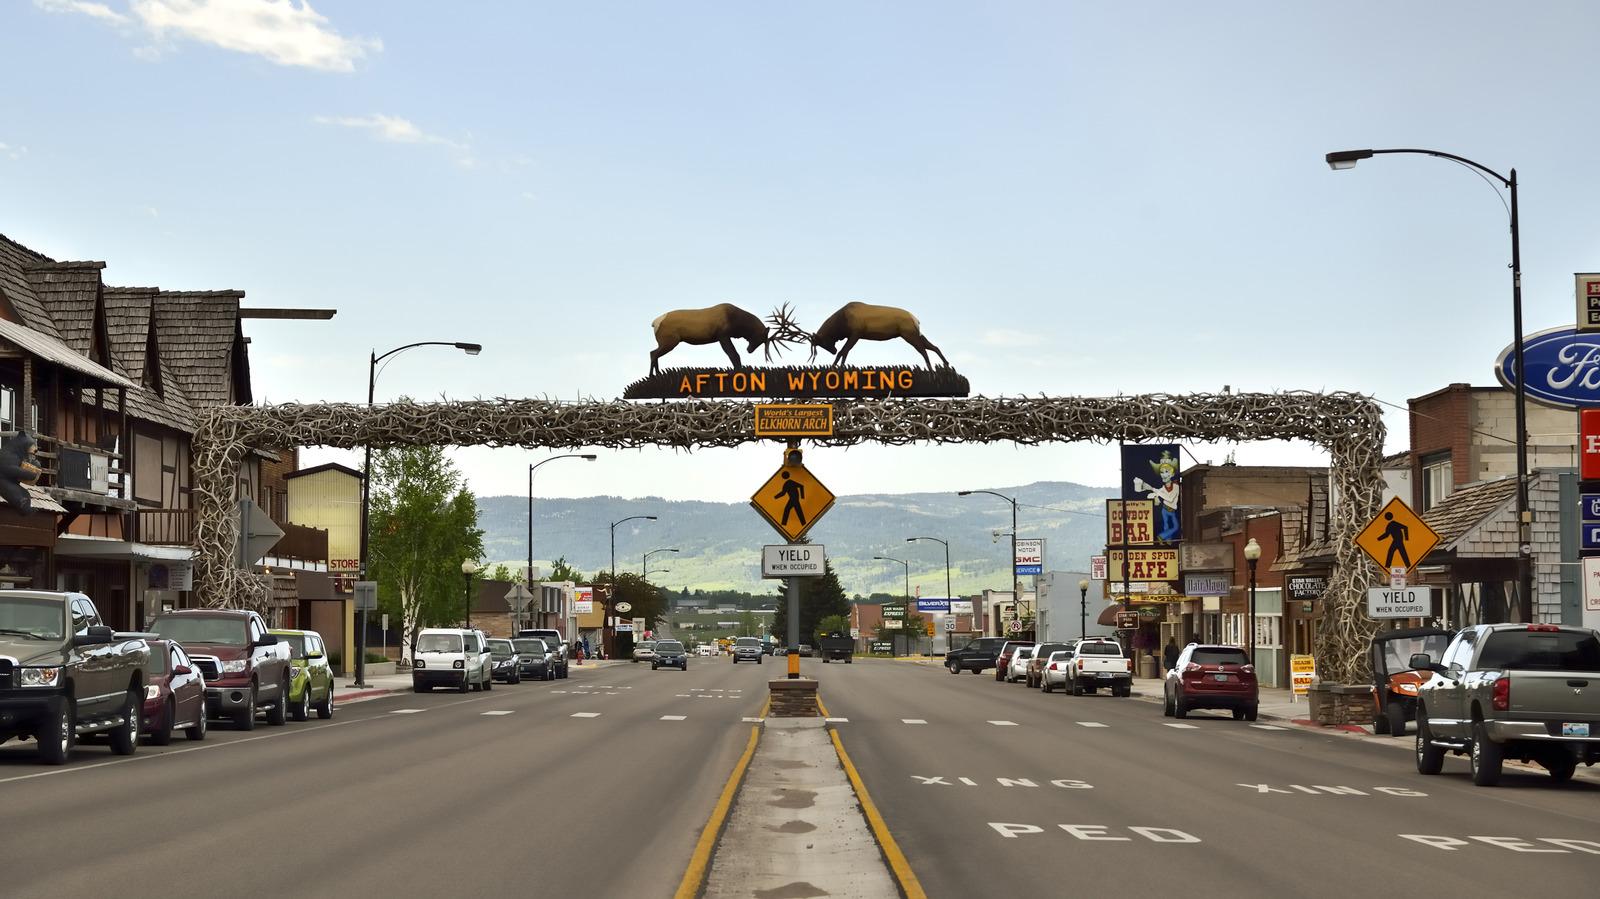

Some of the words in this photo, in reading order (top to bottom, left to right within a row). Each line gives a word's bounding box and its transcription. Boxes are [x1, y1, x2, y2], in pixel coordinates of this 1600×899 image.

[1591, 312, 1600, 321] E
[680, 372, 766, 393] AFTON
[788, 370, 913, 391] WYOMING
[764, 409, 793, 417] World's
[795, 409, 824, 418] Largest
[760, 418, 801, 430] ELKHORN
[802, 418, 827, 430] ARCH
[1112, 523, 1150, 542] BAR
[778, 549, 811, 562] YIELD
[1112, 552, 1147, 561] GODEN
[1151, 551, 1176, 560] SPUR
[330, 560, 359, 569] STORE
[1289, 582, 1328, 591] CHOCOLATE
[1382, 591, 1416, 604] YIELD
[910, 775, 1094, 789] XING
[1235, 783, 1429, 797] XING
[987, 822, 1202, 843] PED
[1397, 834, 1600, 855] PED
